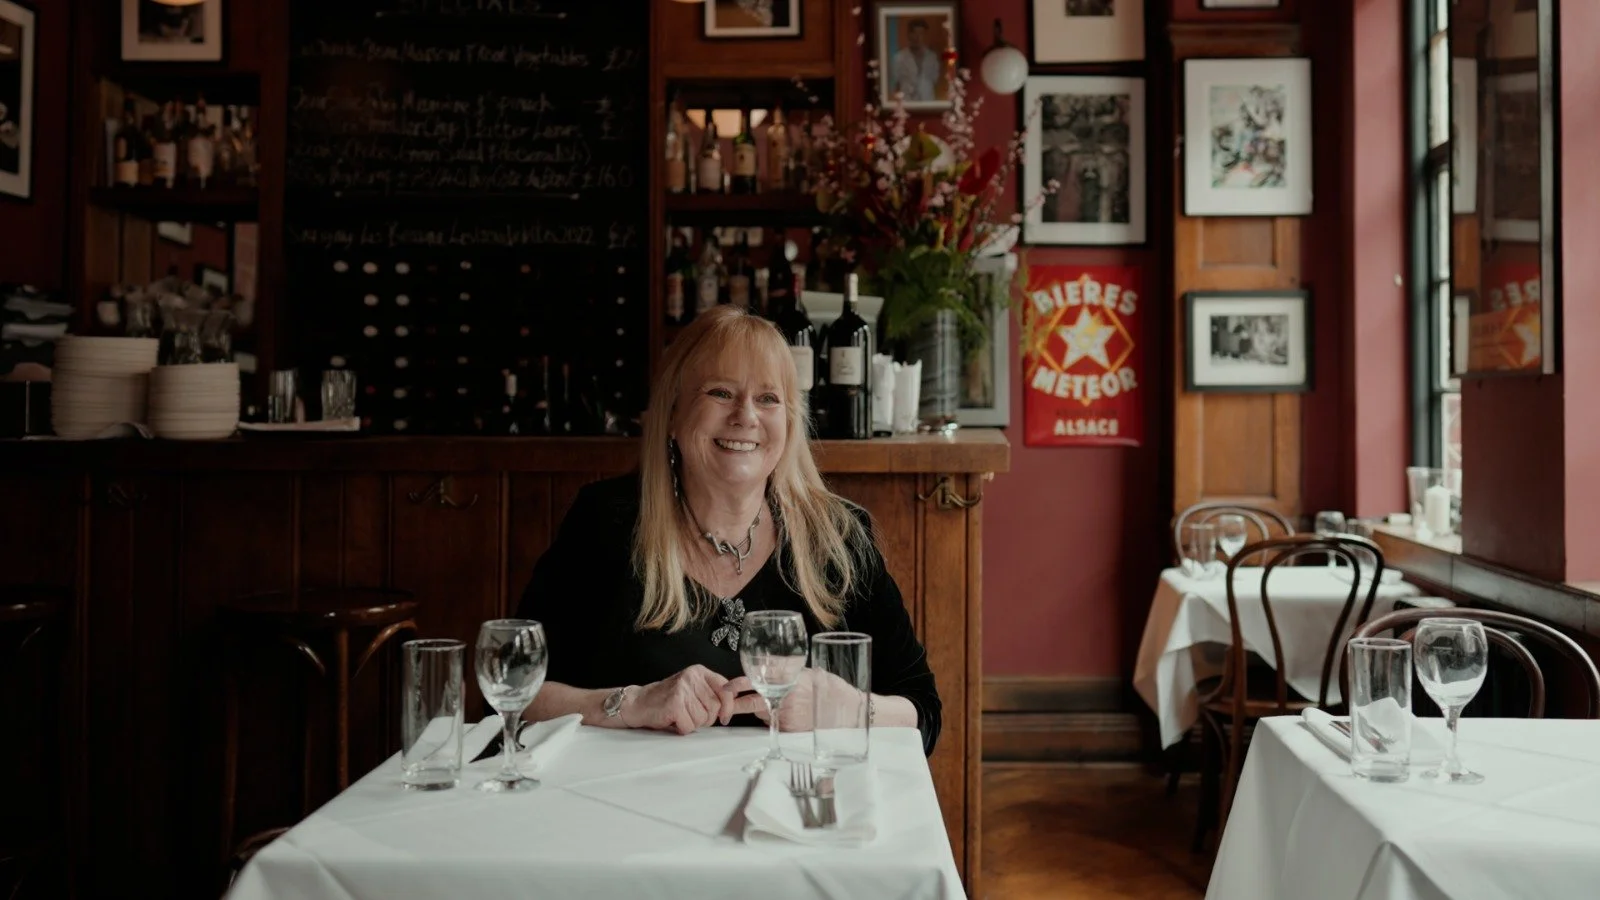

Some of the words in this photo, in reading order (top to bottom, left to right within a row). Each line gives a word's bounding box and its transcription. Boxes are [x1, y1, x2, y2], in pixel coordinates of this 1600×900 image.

[1032, 279, 1138, 316] BIERES
[1032, 366, 1138, 400] METEOR
[1054, 418, 1119, 436] ALSACE
